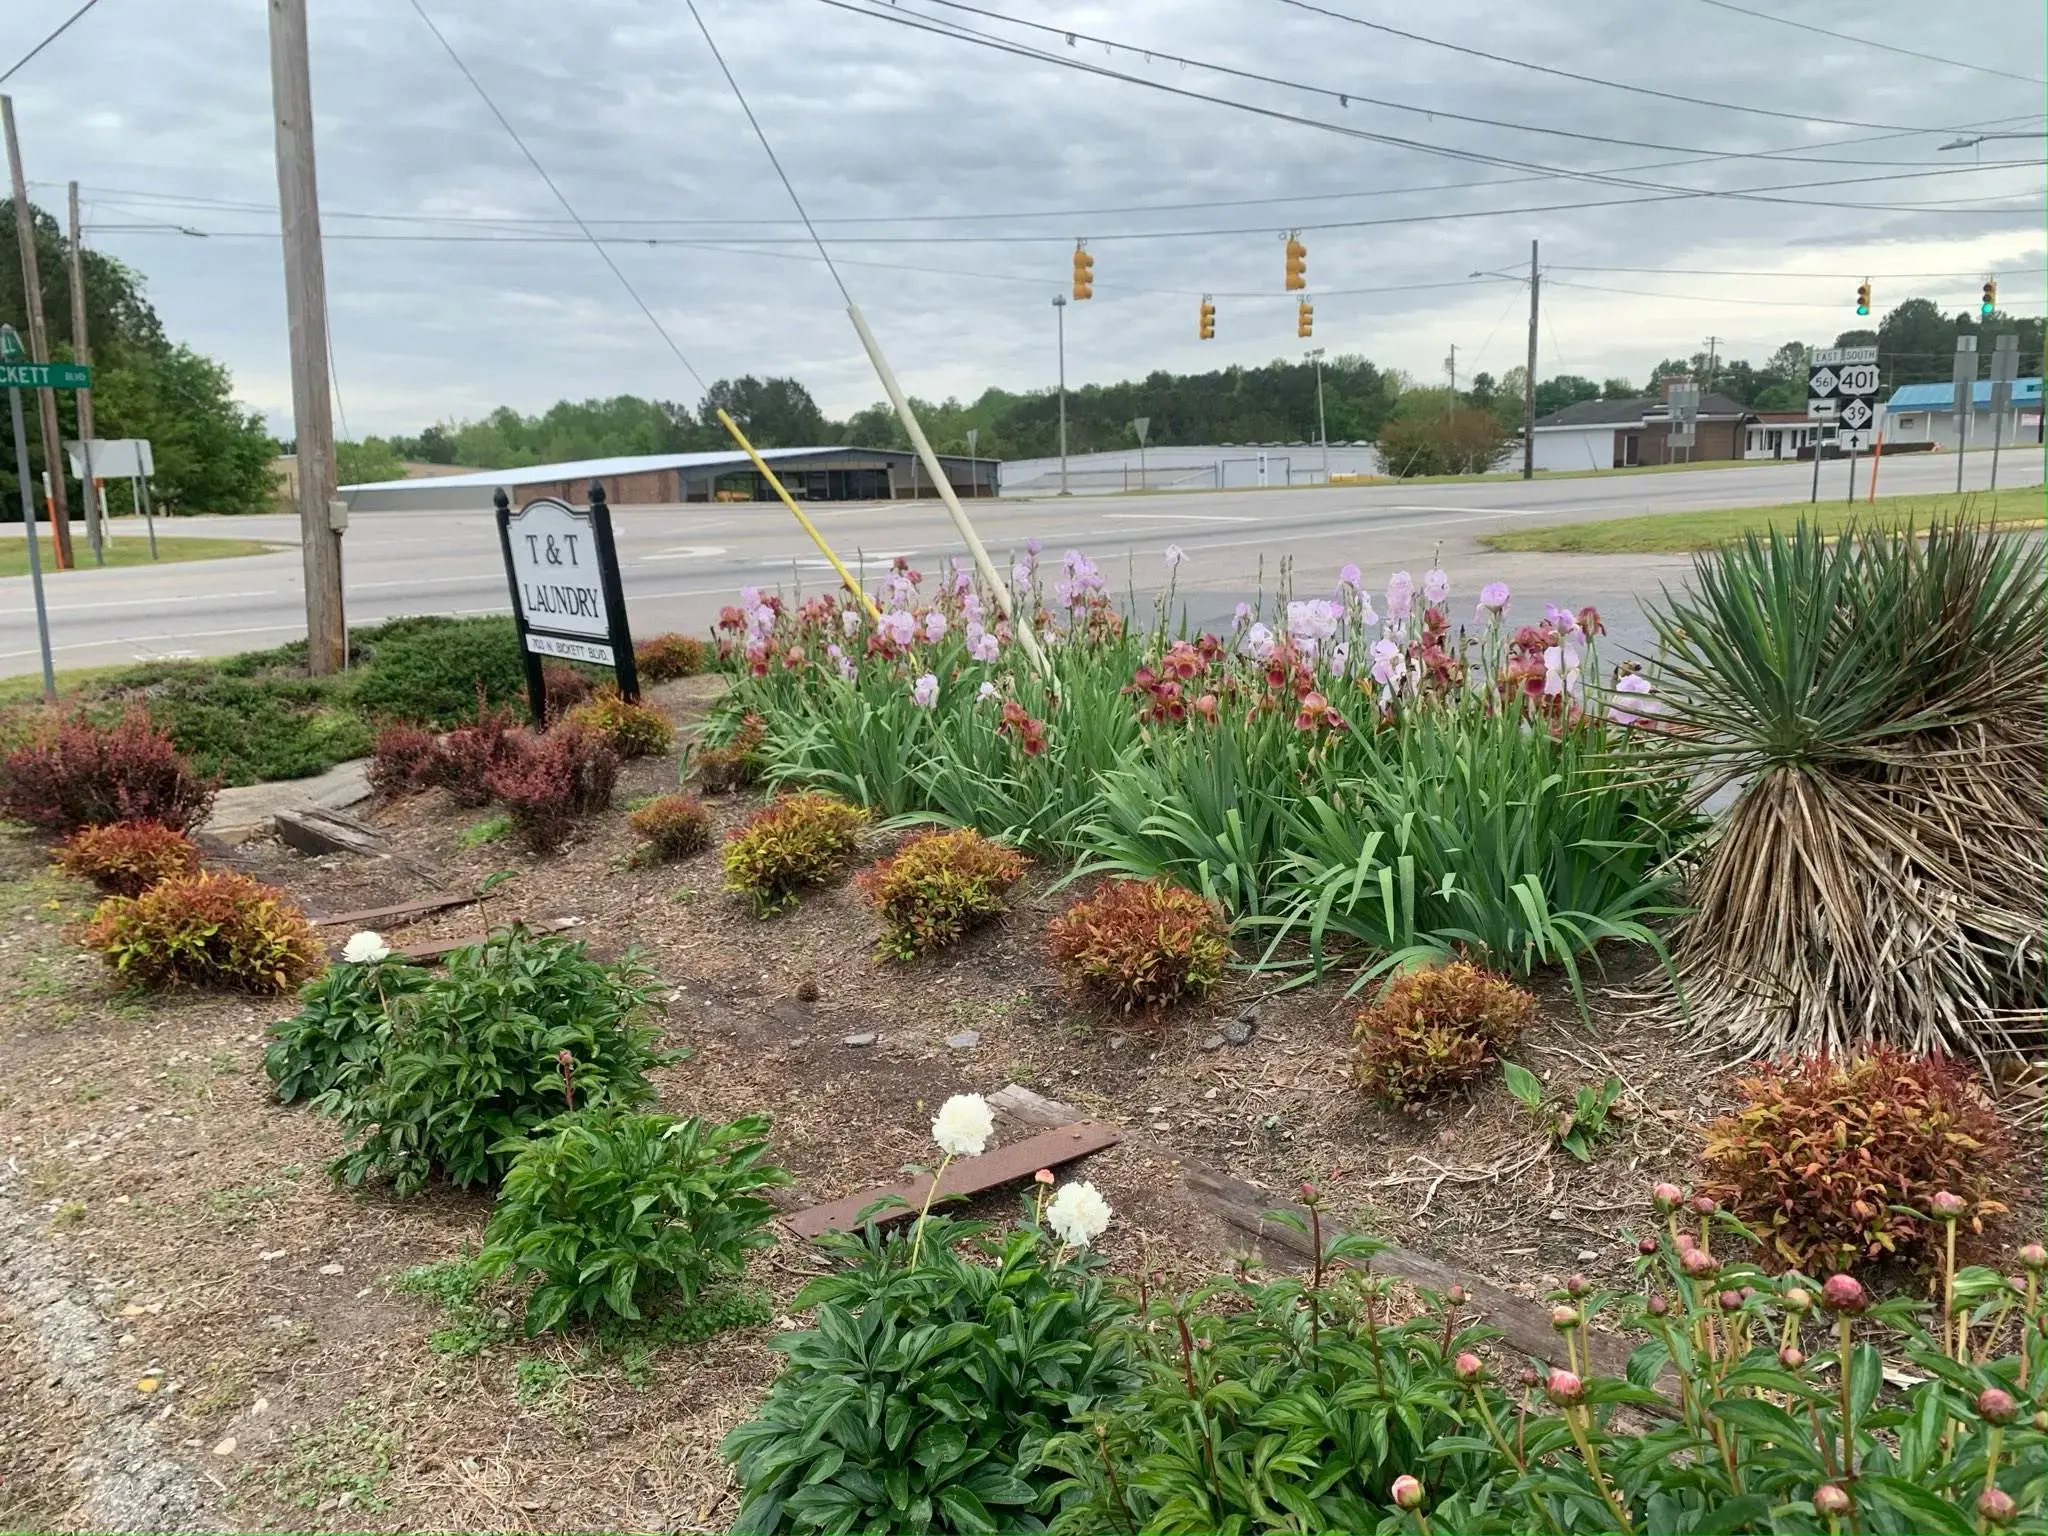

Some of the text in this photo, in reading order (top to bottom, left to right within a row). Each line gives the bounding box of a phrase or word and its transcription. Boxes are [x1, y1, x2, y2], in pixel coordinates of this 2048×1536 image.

[1816, 351, 1838, 361] EAST
[1846, 350, 1875, 360] SOUTH
[1815, 377, 1833, 388] 561
[1841, 371, 1874, 389] 401
[1847, 406, 1866, 421] 39
[525, 534, 579, 565] T & T
[524, 583, 599, 618] LAUNDRY
[556, 642, 584, 657] BICKETT
